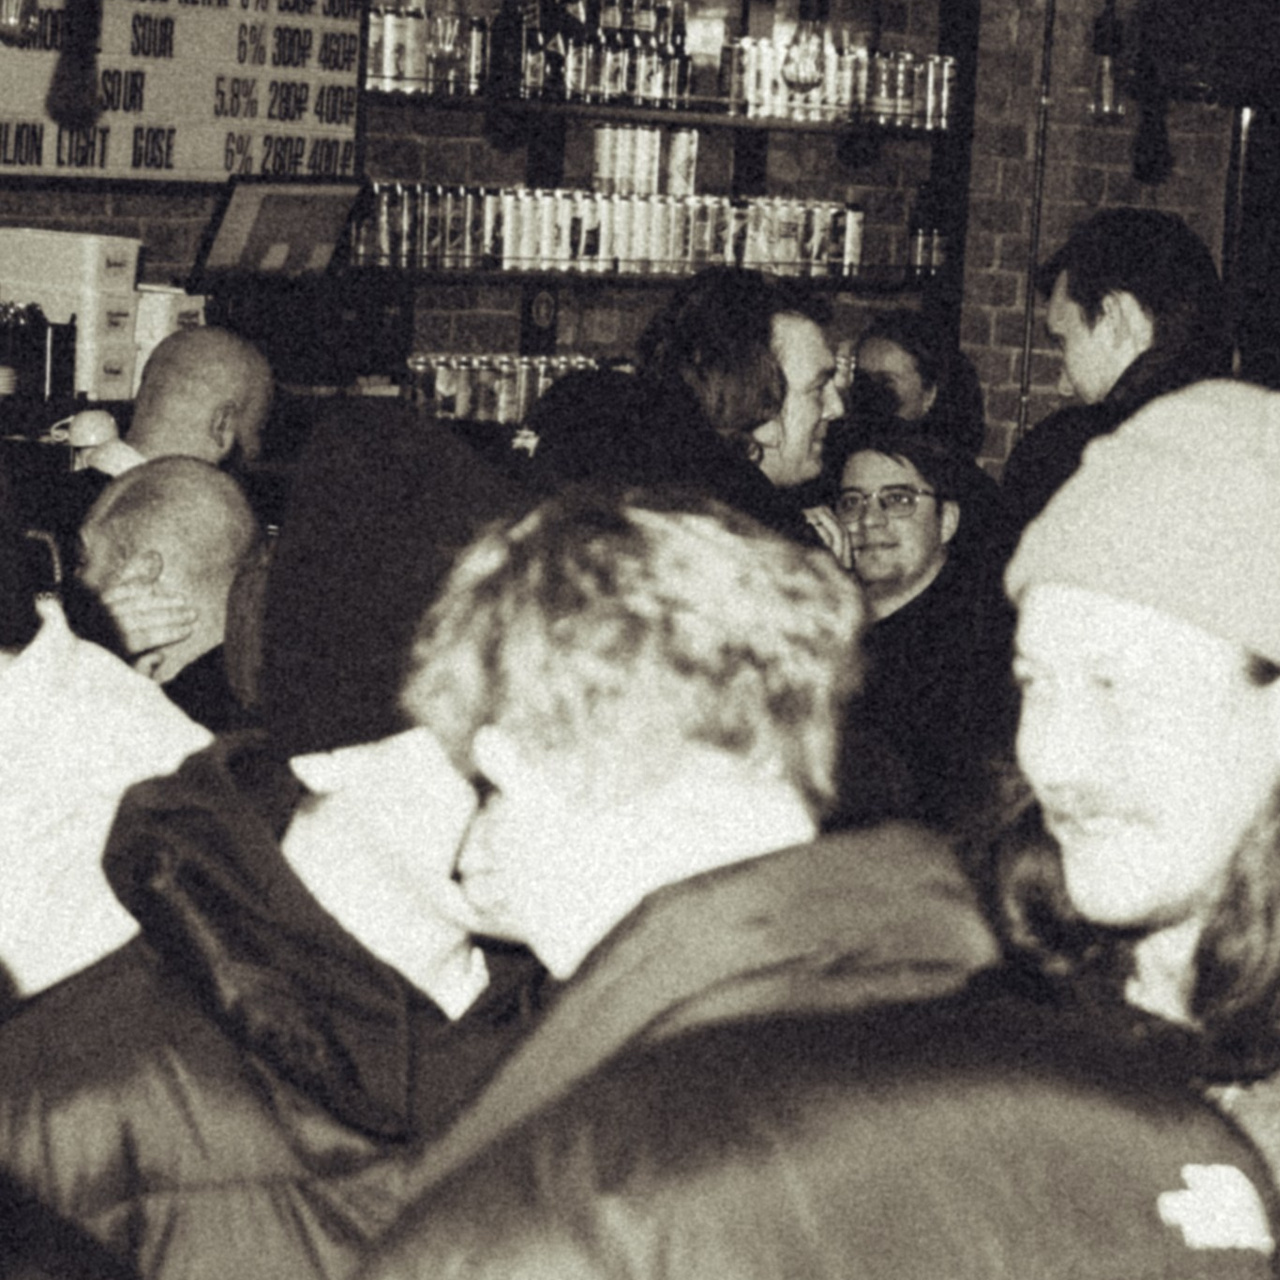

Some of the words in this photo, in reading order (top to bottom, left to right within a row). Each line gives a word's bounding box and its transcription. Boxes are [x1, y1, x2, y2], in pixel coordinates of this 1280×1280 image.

[131, 13, 174, 57] SOUR
[237, 23, 266, 65] 6%
[101, 70, 145, 112] SOUR
[214, 76, 258, 118] 5.8%
[131, 126, 176, 169] GOSE
[225, 132, 253, 175] 6%
